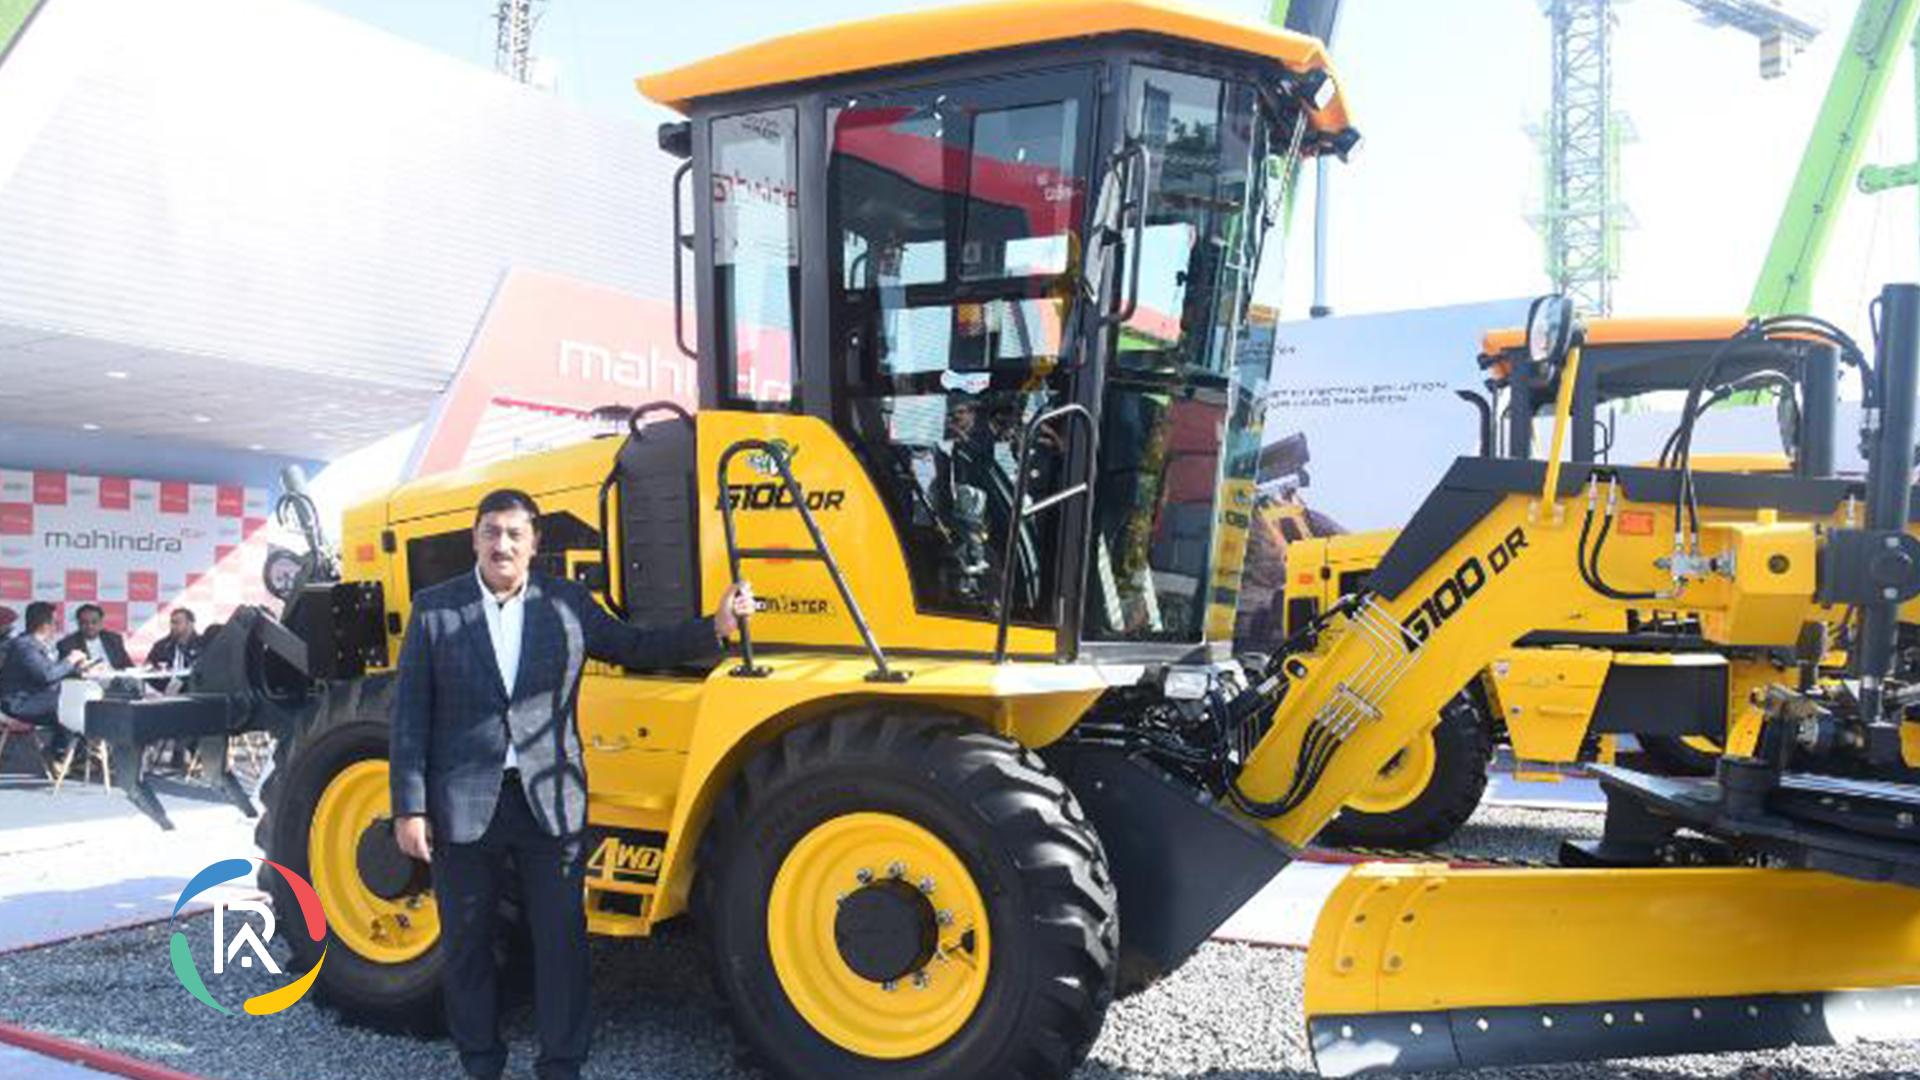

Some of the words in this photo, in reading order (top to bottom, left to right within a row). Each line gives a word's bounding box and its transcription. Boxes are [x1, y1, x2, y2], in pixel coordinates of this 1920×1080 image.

[806, 490, 846, 511] DR
[44, 530, 183, 552] mahindra
[1400, 556, 1486, 653] G100
[1487, 526, 1530, 575] DR
[587, 836, 663, 880] 4WD
